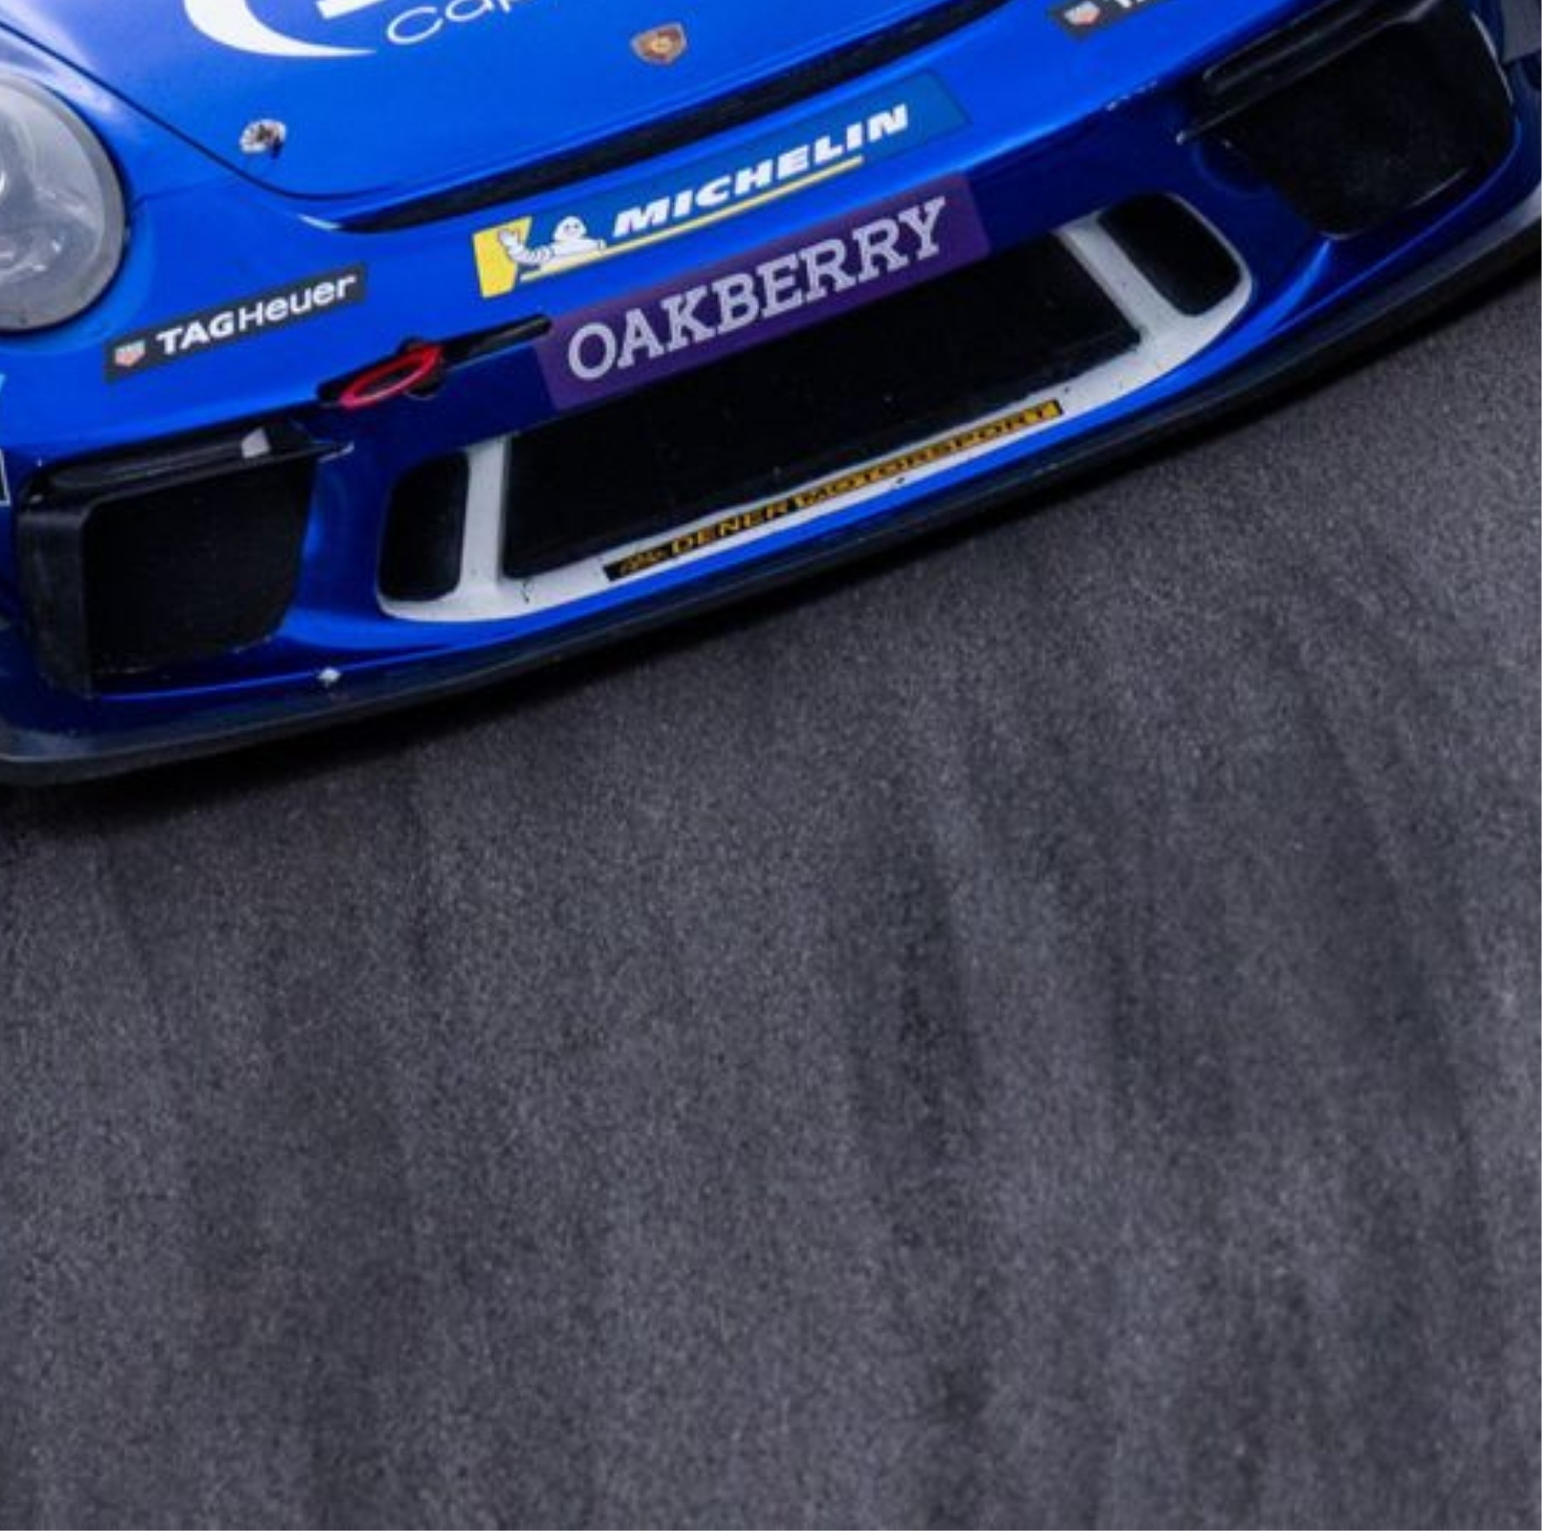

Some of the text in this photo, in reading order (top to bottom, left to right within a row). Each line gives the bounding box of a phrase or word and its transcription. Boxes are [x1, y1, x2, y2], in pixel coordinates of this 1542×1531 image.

[612, 102, 909, 238] MICHELIN
[567, 195, 948, 381] OAKBERRY
[672, 501, 791, 556] DENER
